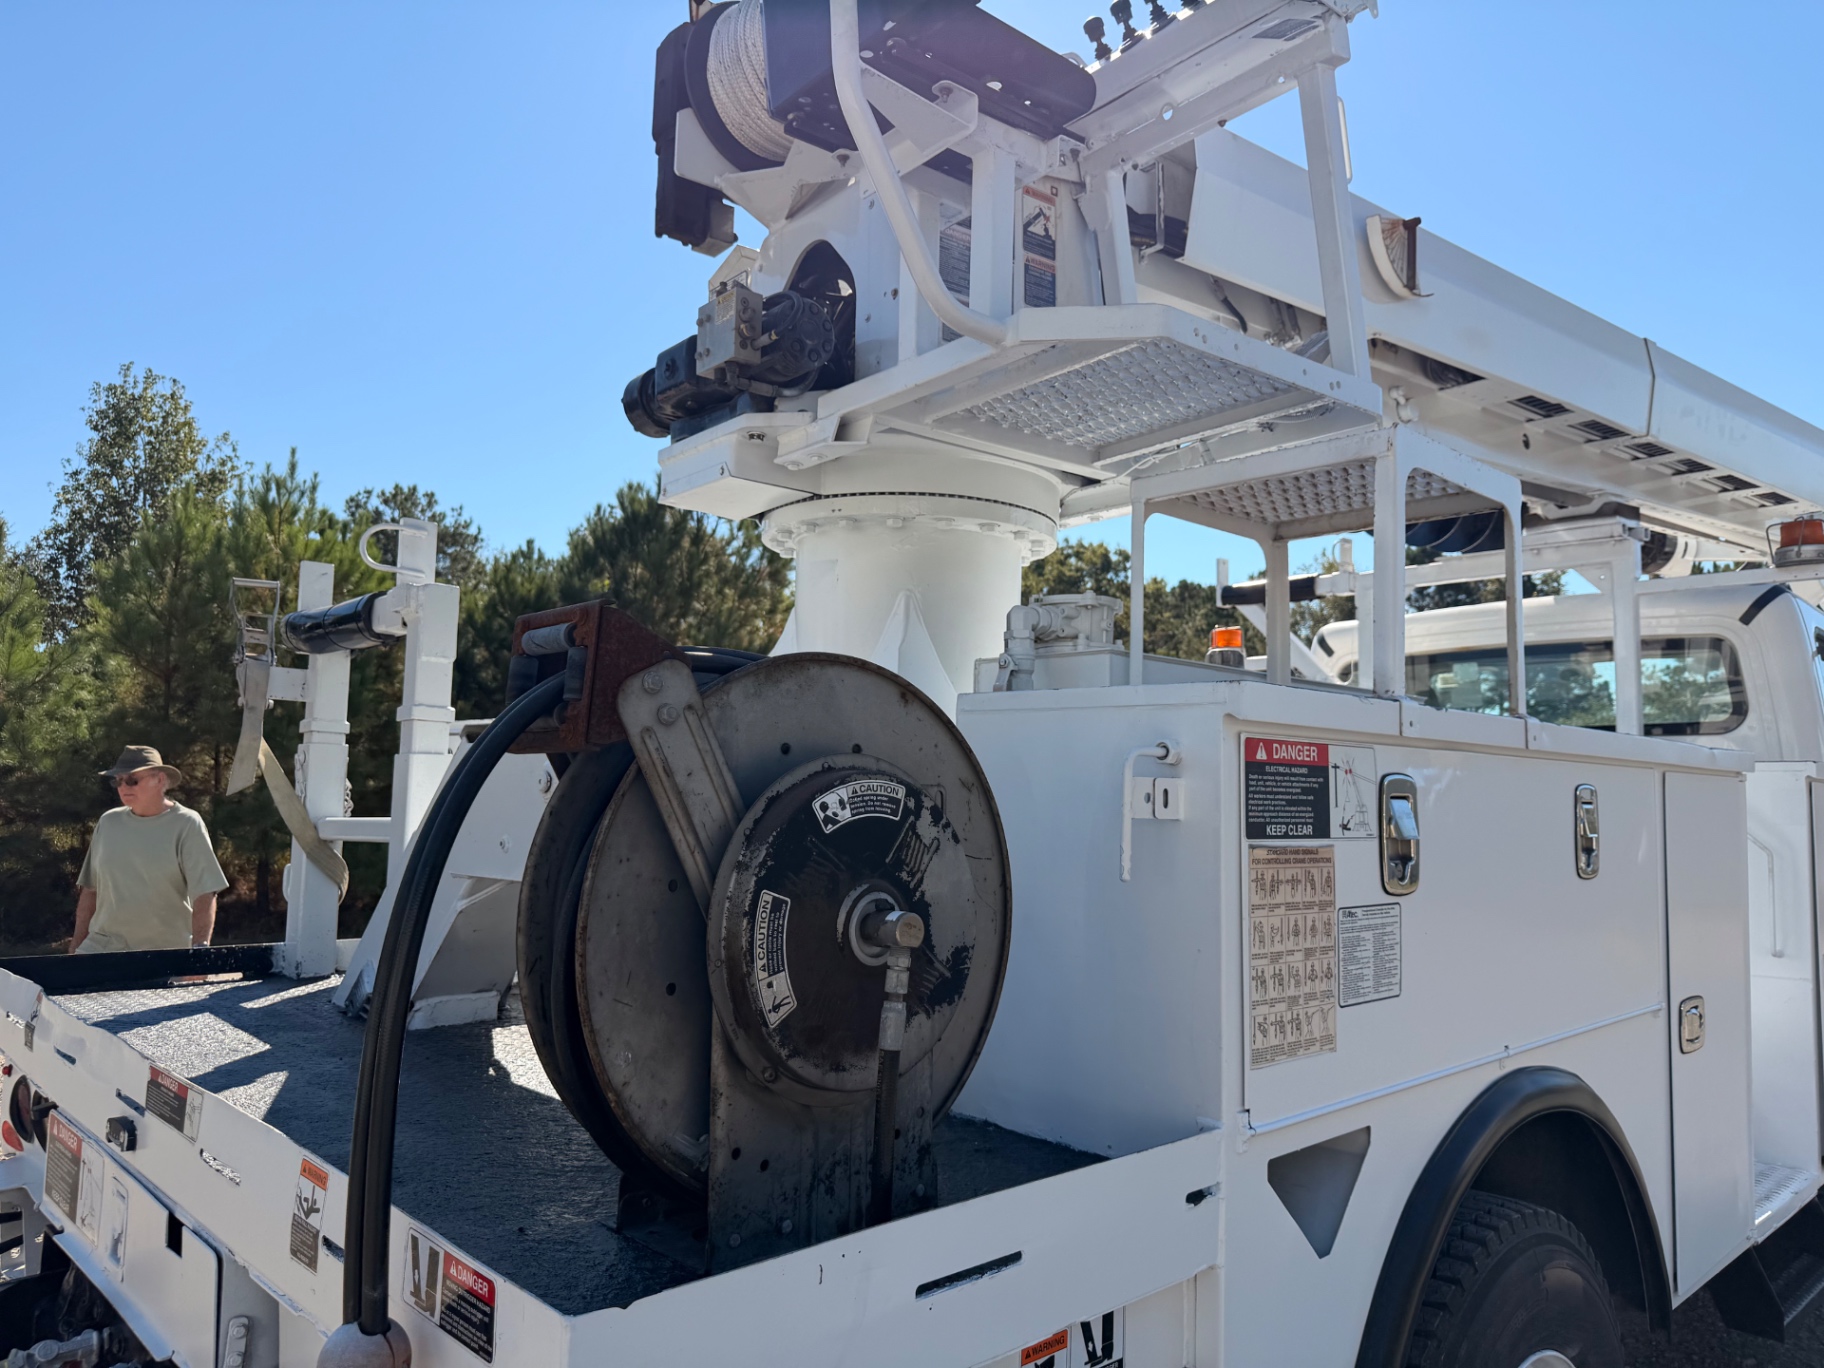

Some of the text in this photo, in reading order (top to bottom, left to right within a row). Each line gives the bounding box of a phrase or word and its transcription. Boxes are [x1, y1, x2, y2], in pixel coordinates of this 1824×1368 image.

[1273, 744, 1318, 762] DANGER
[860, 784, 899, 796] CAUTION
[1266, 824, 1312, 835] KEEP CLEAR
[758, 900, 770, 960] CAUTION
[162, 1074, 178, 1092] DANGER
[59, 1124, 78, 1151] DANGER
[308, 1168, 326, 1186] WARNING
[457, 1266, 489, 1298] DANGER
[1032, 1336, 1064, 1355] WARNING
